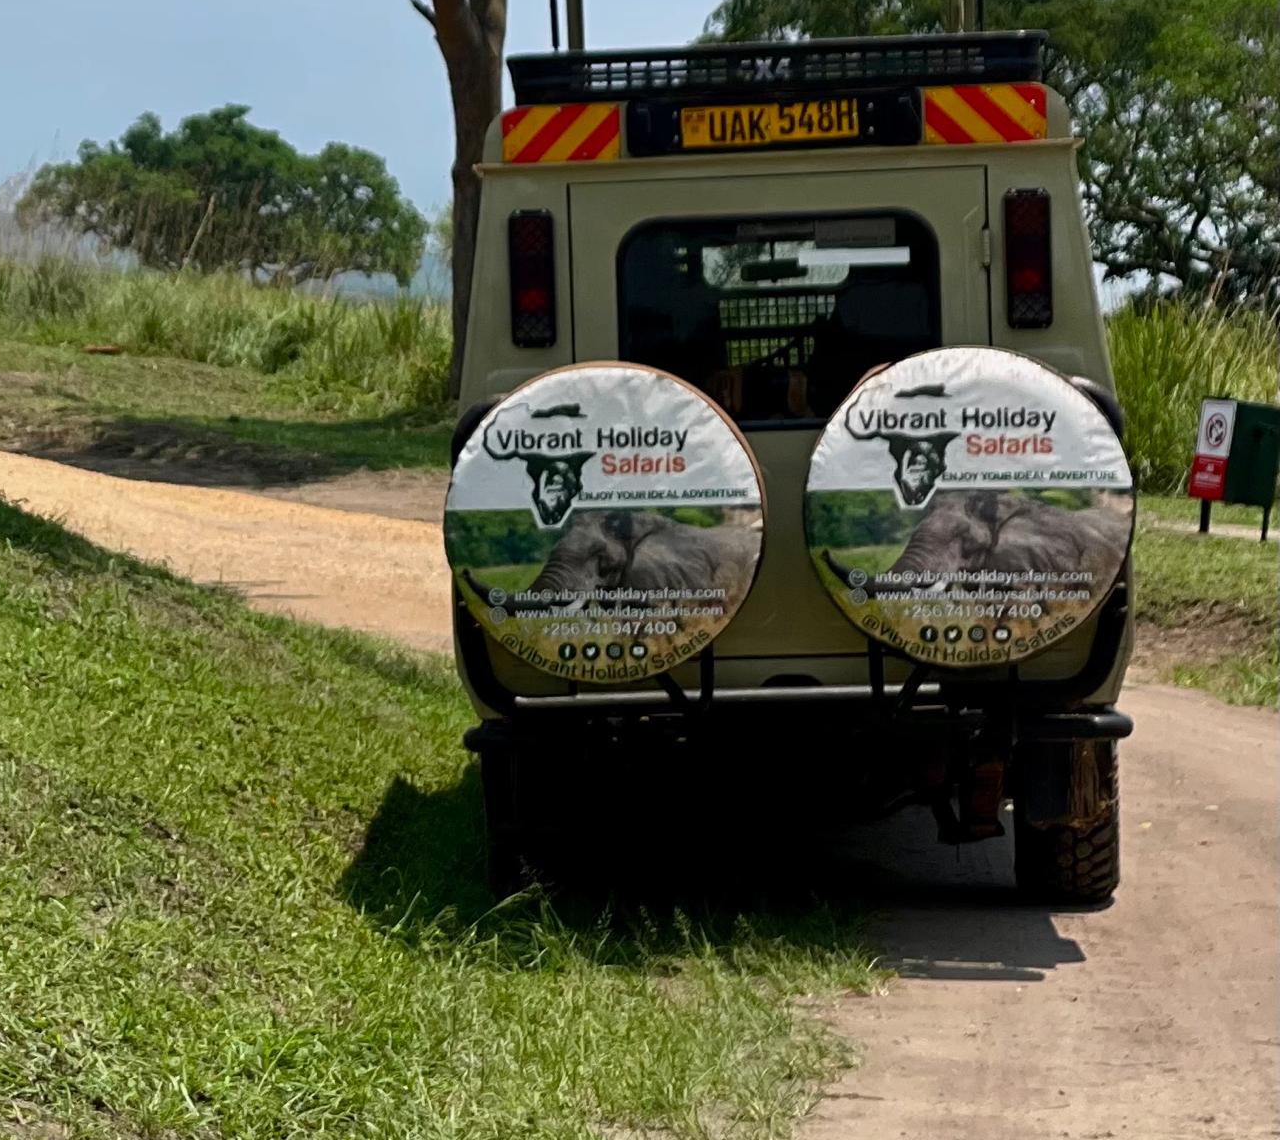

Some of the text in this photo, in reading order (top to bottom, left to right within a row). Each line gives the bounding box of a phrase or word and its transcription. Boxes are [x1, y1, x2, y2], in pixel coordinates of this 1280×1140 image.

[709, 99, 855, 142] UAK 548H
[859, 406, 1056, 433] Vibrant Holiday
[496, 426, 689, 452] Vibrant Holiday
[966, 433, 1053, 456] Safaris
[601, 452, 687, 476] Safaris
[942, 471, 978, 482] ENJOY
[1048, 469, 1119, 481] ADVENTURE
[578, 490, 614, 501] ENJOY
[617, 489, 648, 500] YOUR
[681, 487, 749, 500] ADVENTURE
[875, 568, 1094, 585] info@vibrantholidaysafaris.com
[515, 586, 726, 603] info@vibrantholidaysafaris.com
[976, 604, 1005, 618] 947
[1007, 603, 1042, 618] 400
[613, 621, 640, 636] 947
[644, 620, 677, 635] 400
[942, 641, 1012, 663] Holiday
[1015, 613, 1077, 653] Safaris
[581, 658, 649, 681] Holiday
[652, 629, 712, 670] Safaris
